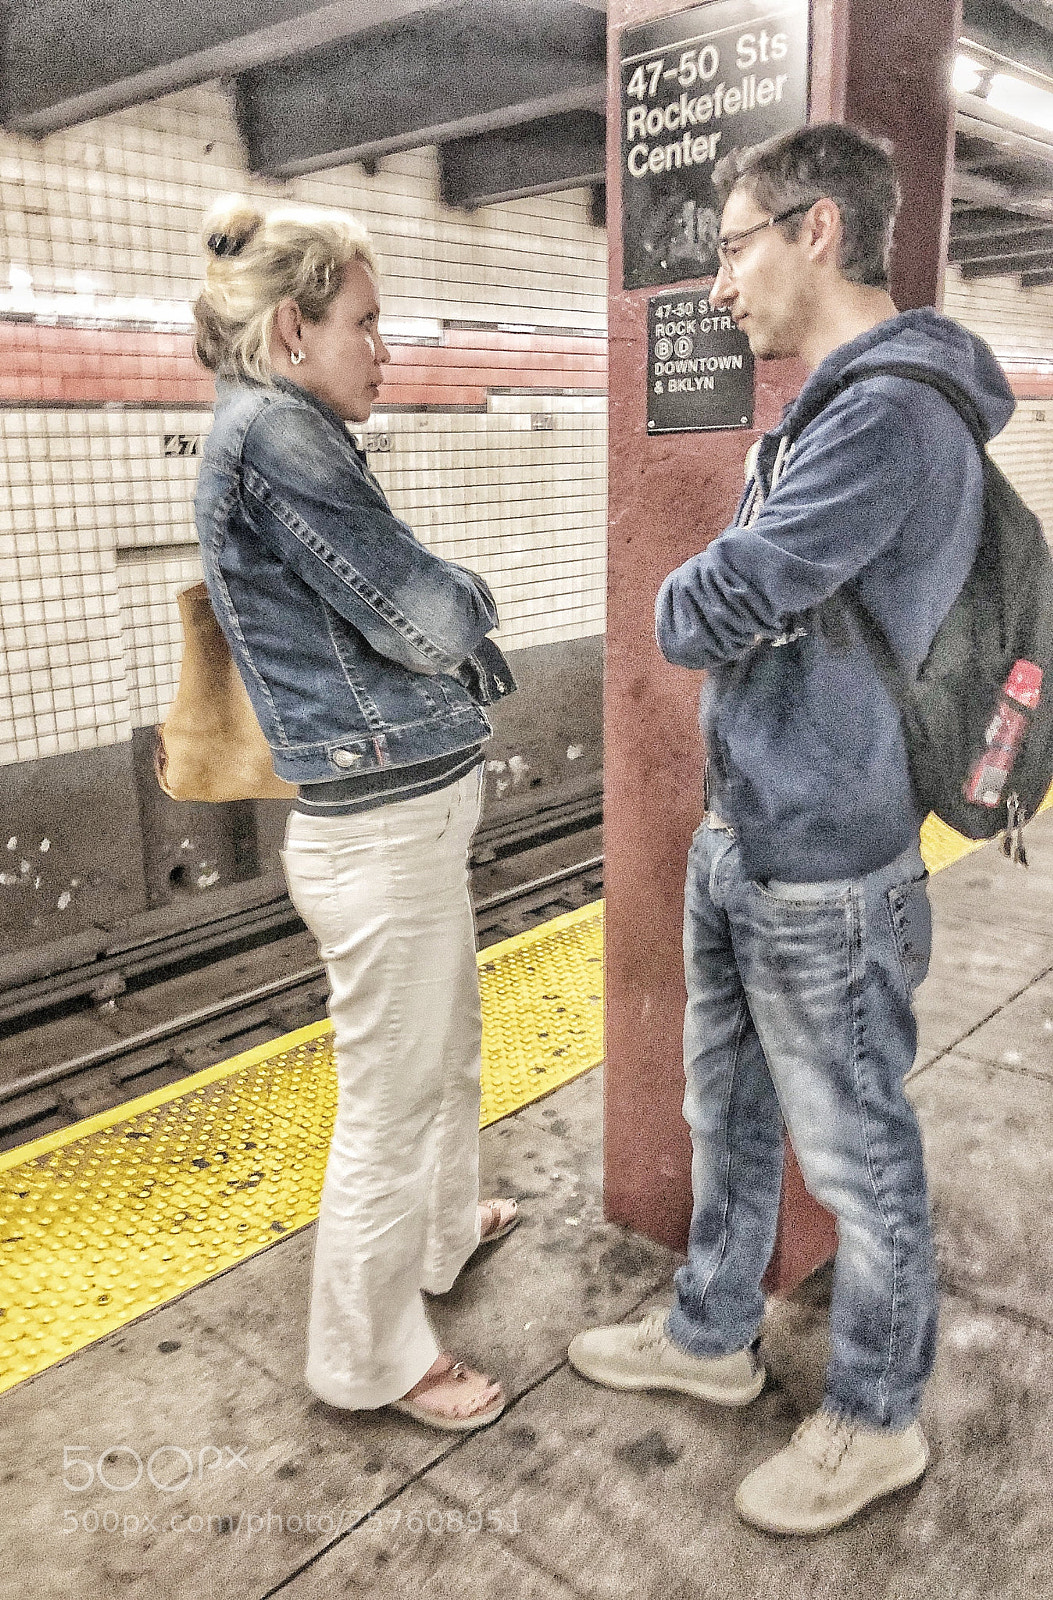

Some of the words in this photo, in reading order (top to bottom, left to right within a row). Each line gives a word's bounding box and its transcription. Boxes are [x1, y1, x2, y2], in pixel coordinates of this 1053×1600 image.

[626, 45, 720, 101] 47-50
[735, 29, 788, 70] Sts
[626, 73, 788, 141] Rockefeller
[627, 131, 722, 178] Center
[654, 302, 694, 319] 47-50
[655, 319, 697, 337] ROCK
[654, 355, 743, 376] DOWNTOWN
[653, 380, 664, 395] &
[668, 376, 715, 393] BKLYN
